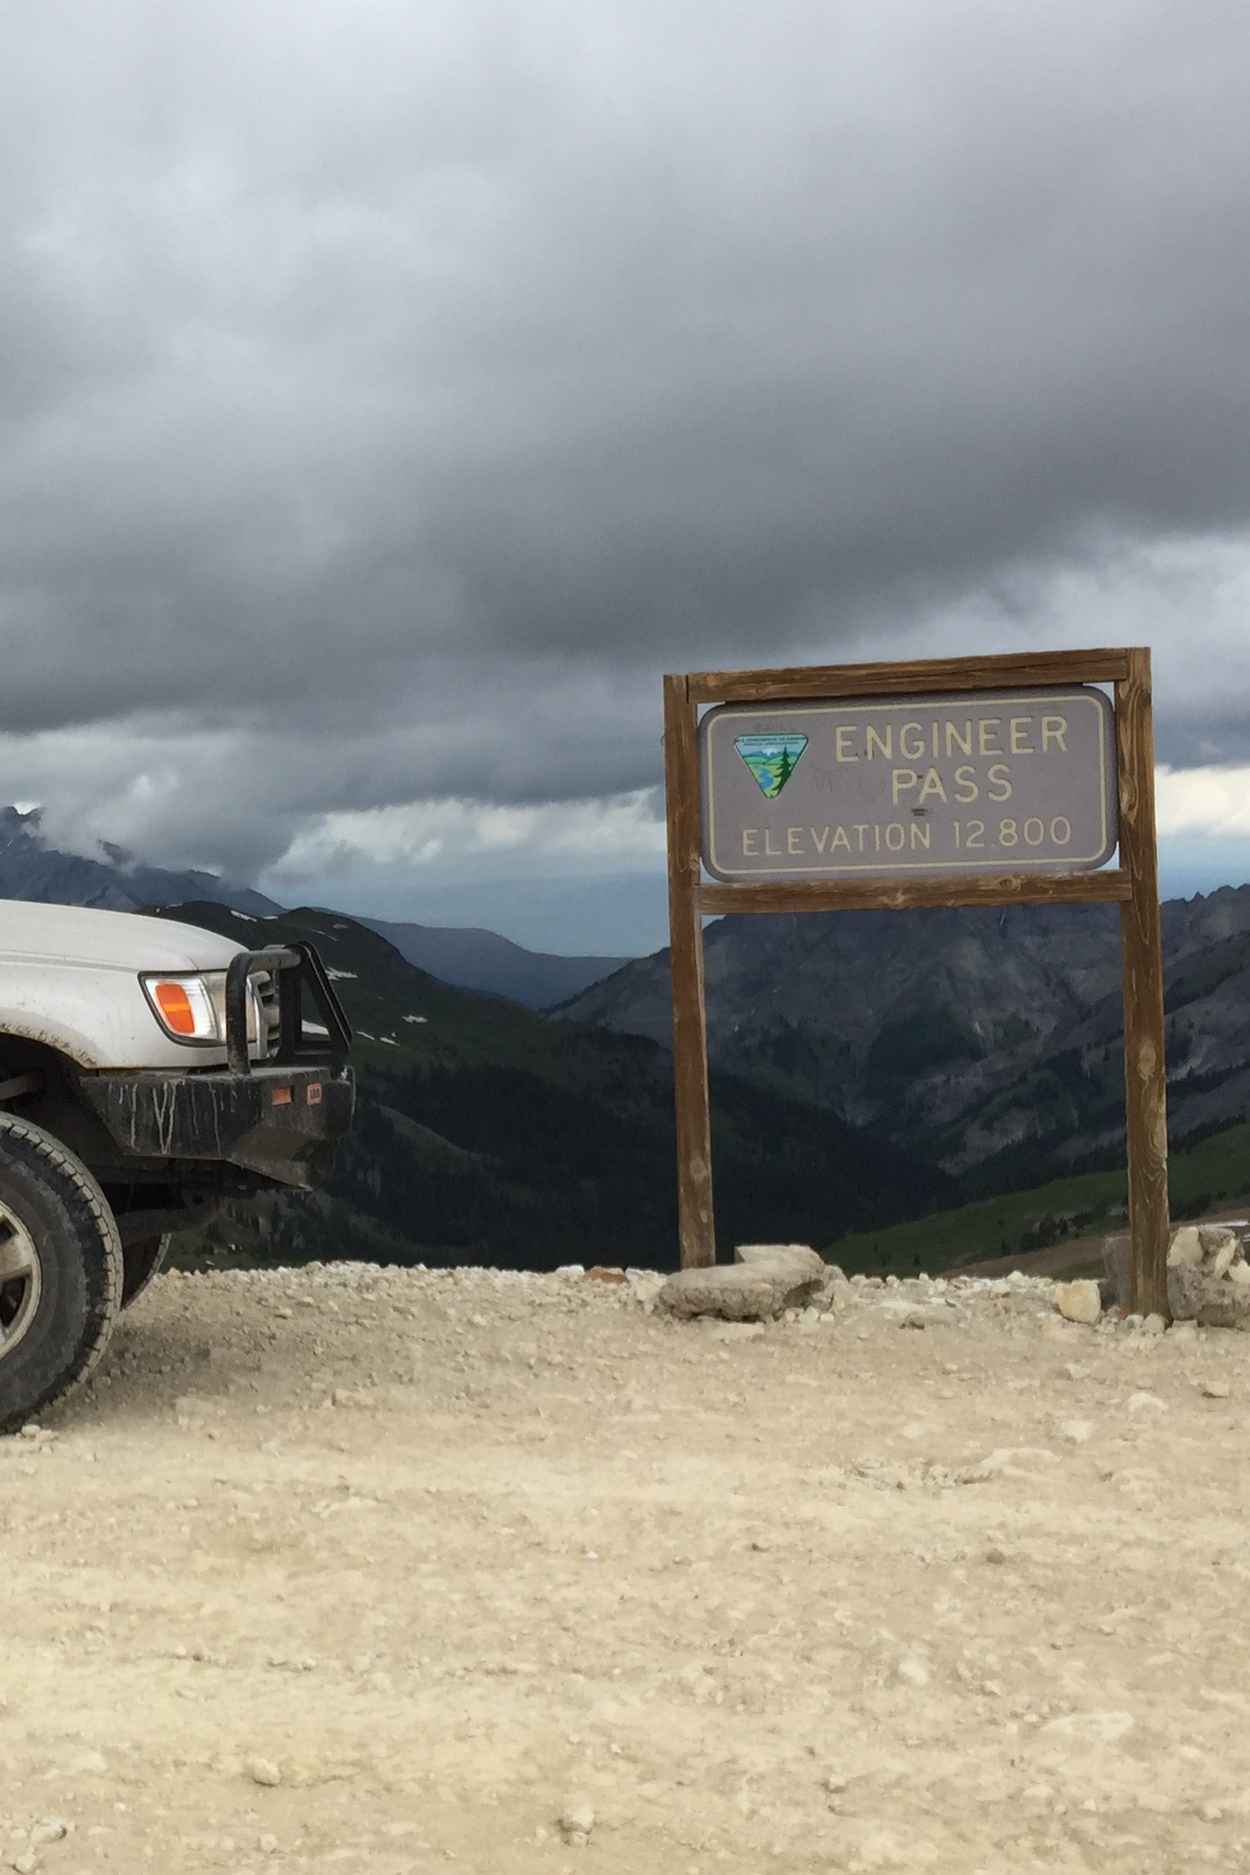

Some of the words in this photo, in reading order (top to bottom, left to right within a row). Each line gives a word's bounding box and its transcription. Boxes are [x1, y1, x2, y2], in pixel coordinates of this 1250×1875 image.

[835, 715, 1068, 763] ENGINEER
[891, 763, 1013, 805] PASS
[742, 823, 931, 857] ELEVATION
